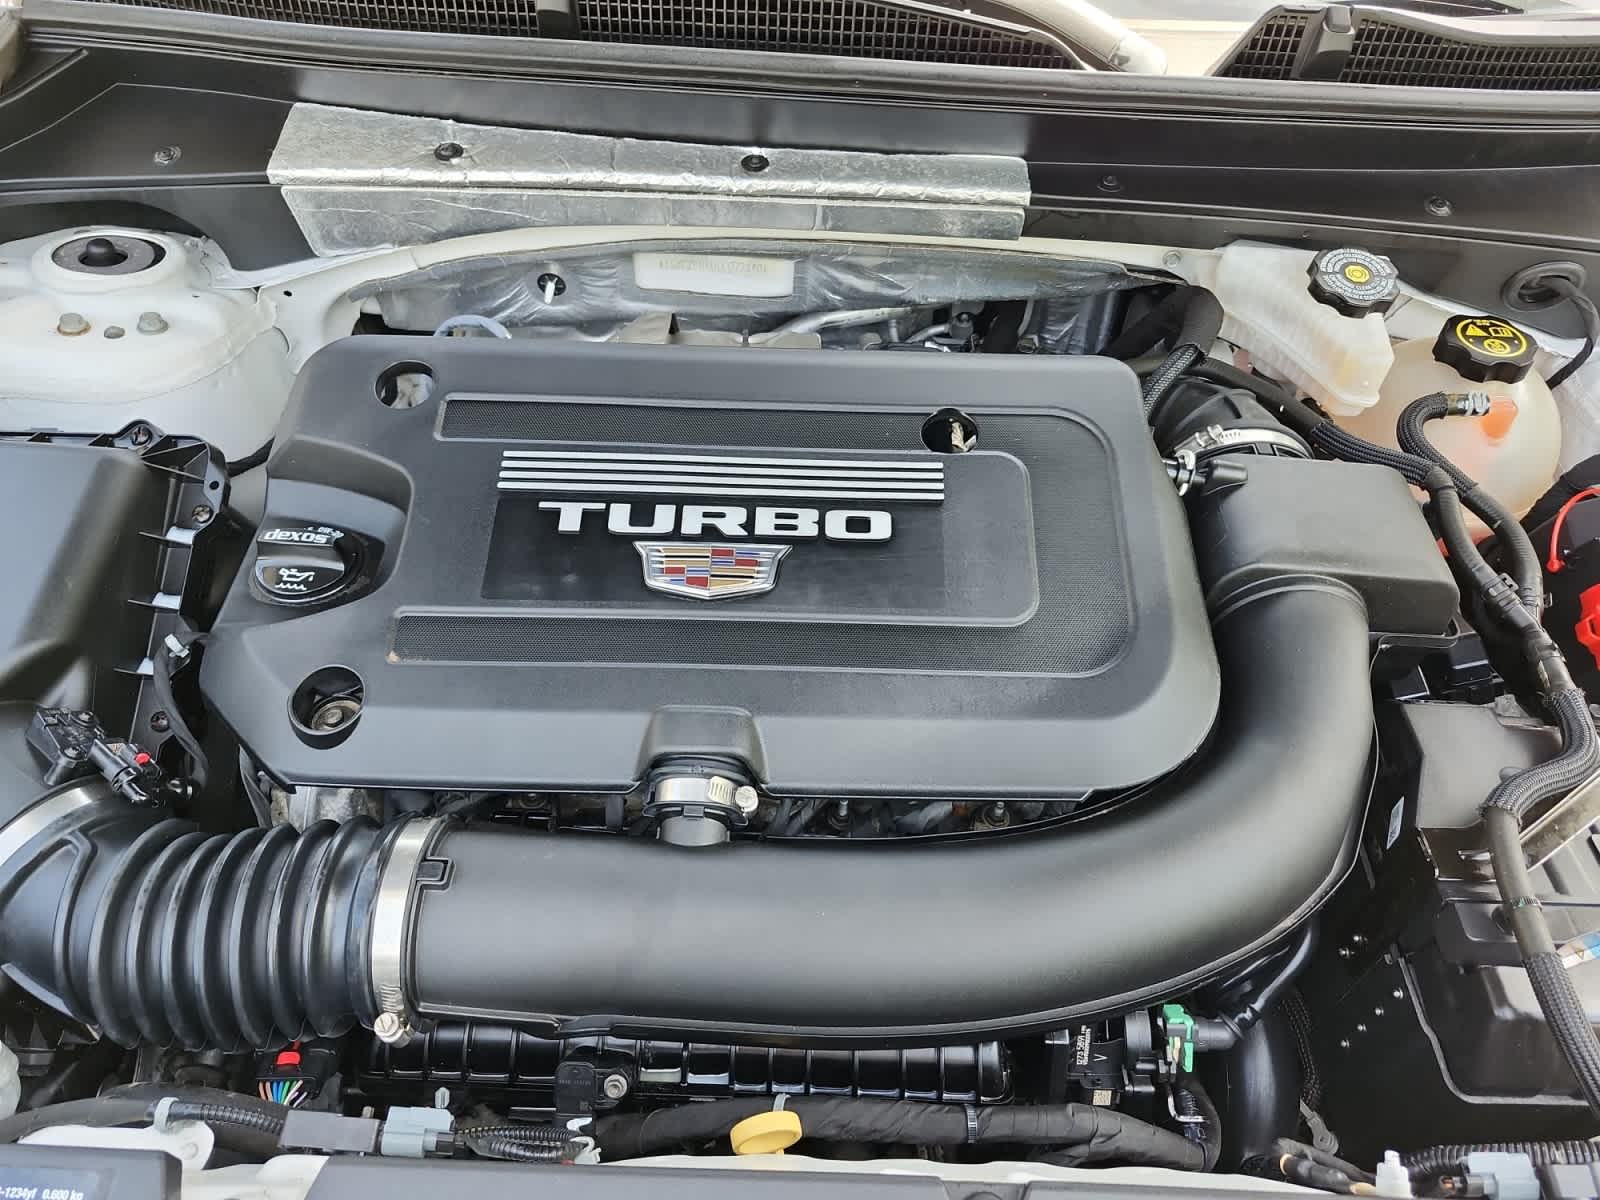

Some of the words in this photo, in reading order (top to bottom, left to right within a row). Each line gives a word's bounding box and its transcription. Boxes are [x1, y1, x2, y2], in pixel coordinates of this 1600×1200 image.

[538, 501, 893, 541] TURBO
[264, 529, 330, 544] dexos
[0, 1186, 38, 1200] -1234yf
